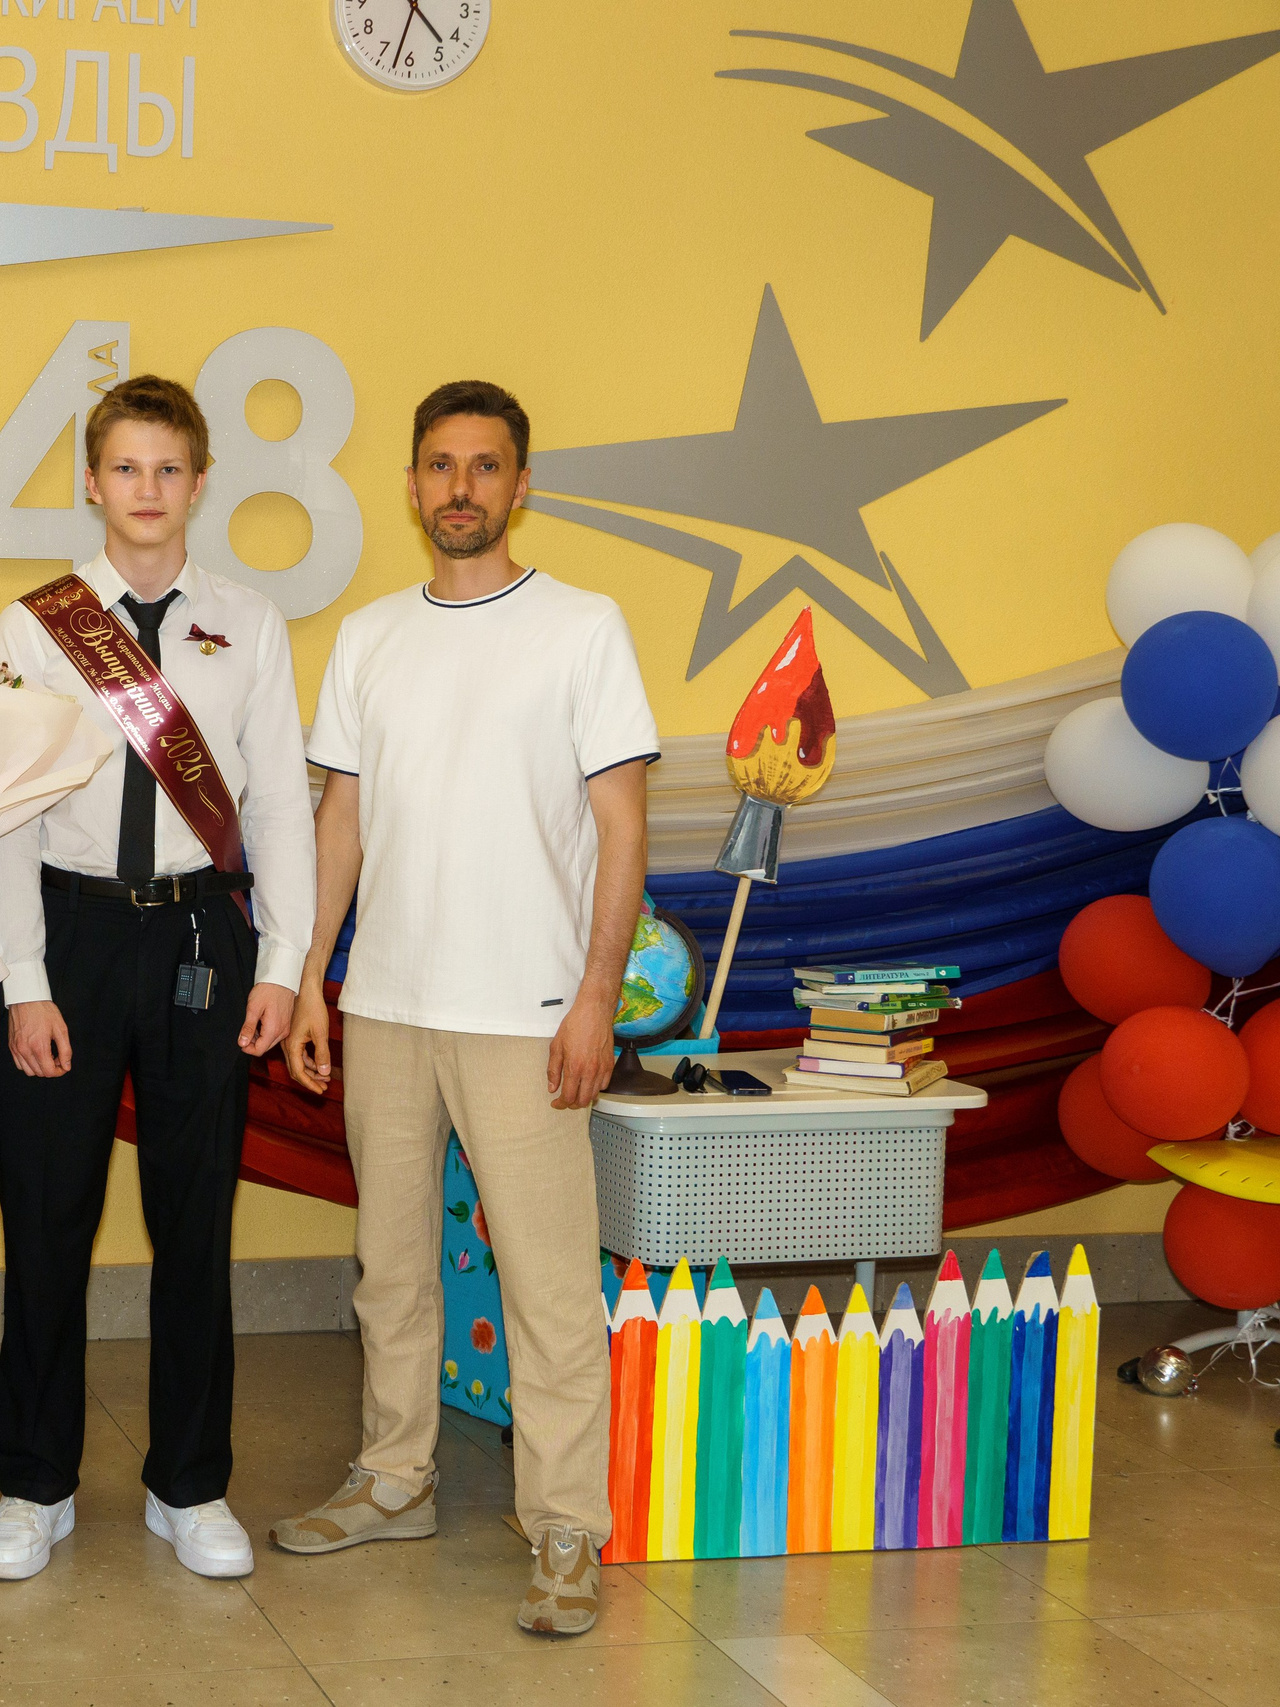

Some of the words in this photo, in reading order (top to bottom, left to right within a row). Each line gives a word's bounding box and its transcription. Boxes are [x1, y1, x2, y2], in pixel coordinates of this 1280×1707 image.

[460, 3, 469, 19] 3
[364, 19, 373, 35] 8
[450, 27, 460, 42] 4
[380, 41, 390, 57] 7
[433, 46, 444, 62] 5
[404, 51, 415, 67] 6
[35, 597, 45, 606] 11
[54, 582, 74, 594] класс
[55, 626, 78, 648] МАОУ
[73, 650, 91, 667] СОШ
[87, 668, 98, 678] №
[95, 676, 104, 686] 48
[70, 607, 164, 727] Выпускник
[150, 682, 174, 712] Михаил
[157, 727, 212, 782] 2026
[860, 971, 909, 981] ЛИТЕРАТУРА
